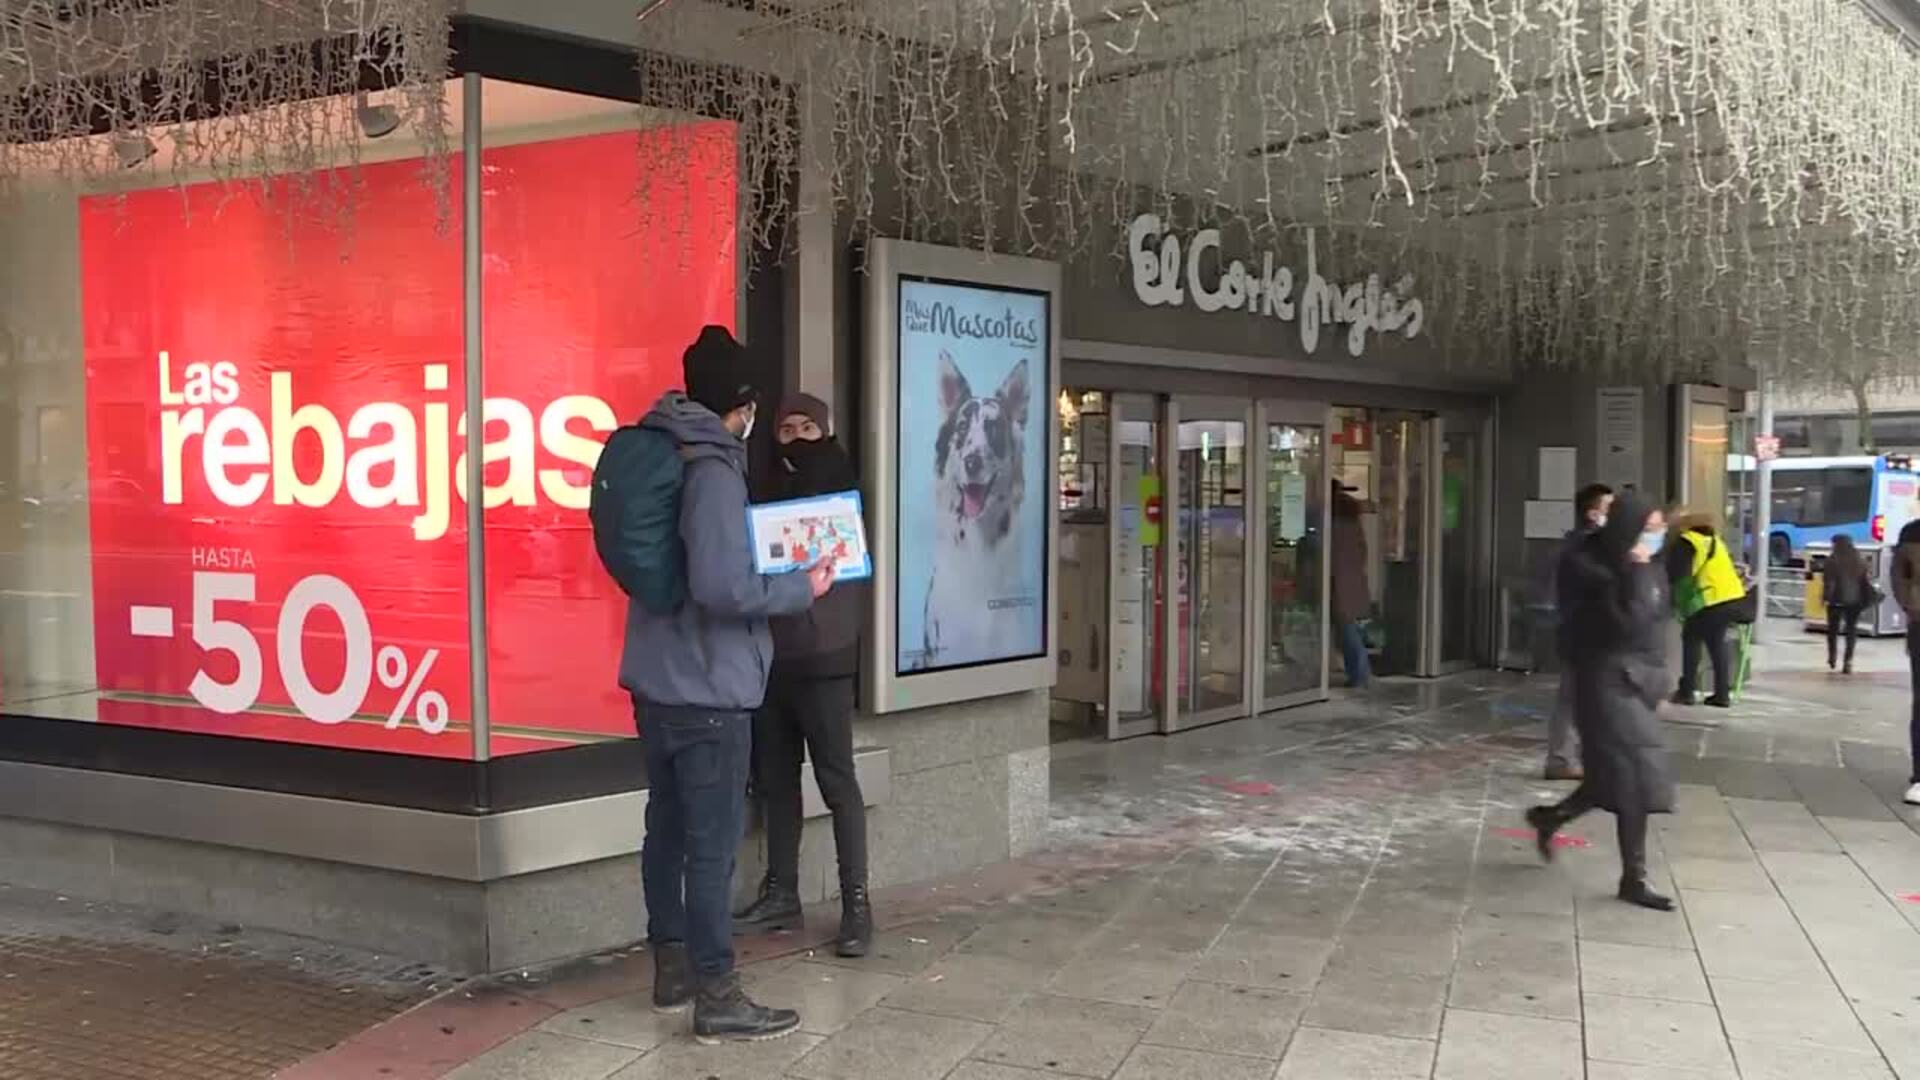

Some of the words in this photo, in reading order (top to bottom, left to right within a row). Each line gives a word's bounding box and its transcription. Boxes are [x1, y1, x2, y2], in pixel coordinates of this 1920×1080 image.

[930, 301, 1038, 343] Mascotas
[1129, 213, 1184, 306] El
[1187, 228, 1295, 321] Corte
[1301, 227, 1424, 356] Inglés
[159, 350, 240, 405] Las
[161, 363, 618, 541] rebajas
[191, 547, 256, 568] HASTA
[131, 570, 450, 735] -50%
